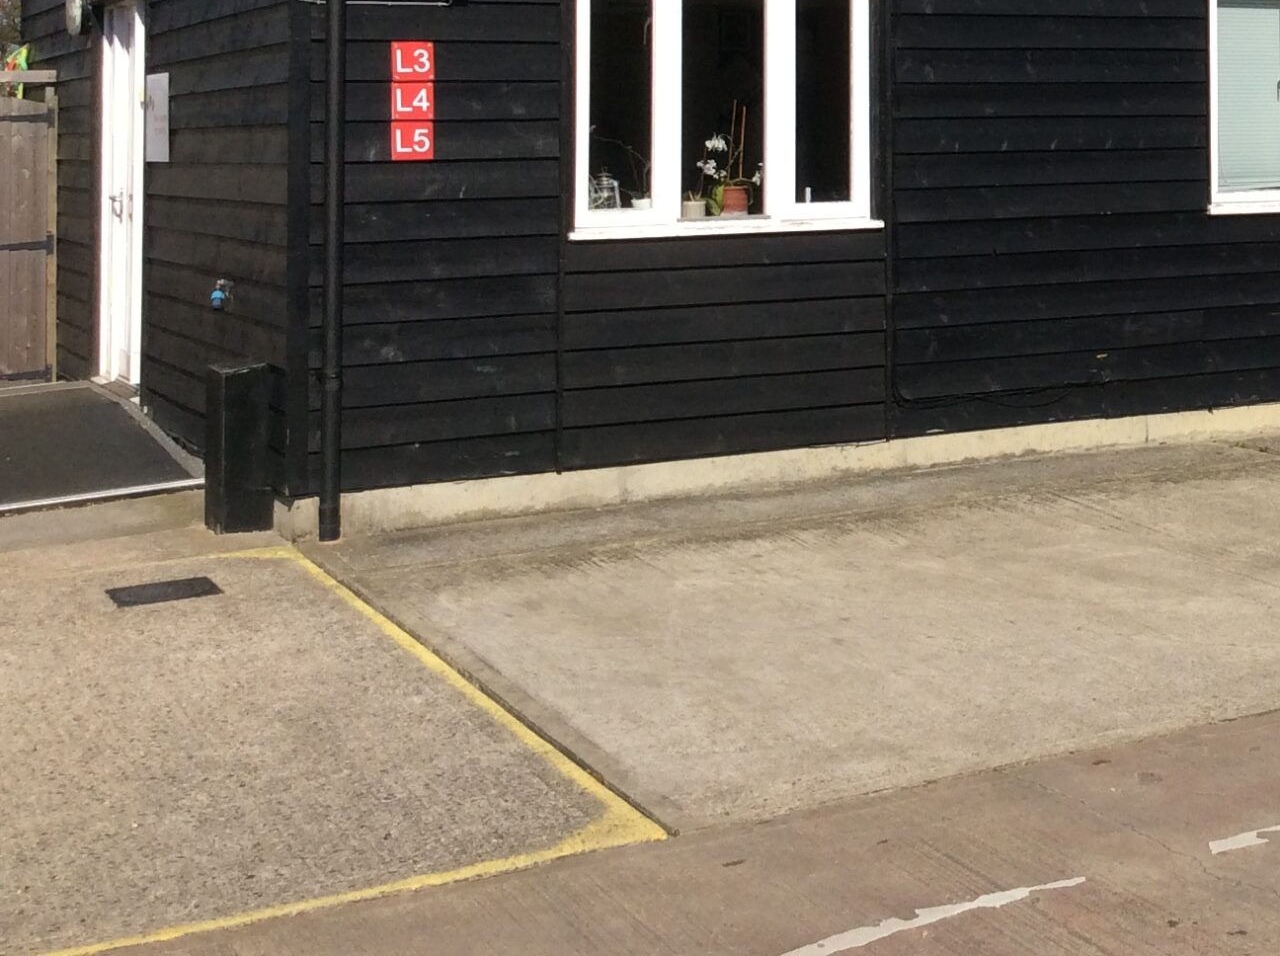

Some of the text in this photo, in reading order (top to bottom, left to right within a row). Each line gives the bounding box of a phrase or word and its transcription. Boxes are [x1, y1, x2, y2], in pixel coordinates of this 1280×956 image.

[396, 49, 430, 73] L3
[396, 88, 430, 112] L4
[396, 129, 430, 153] L5
